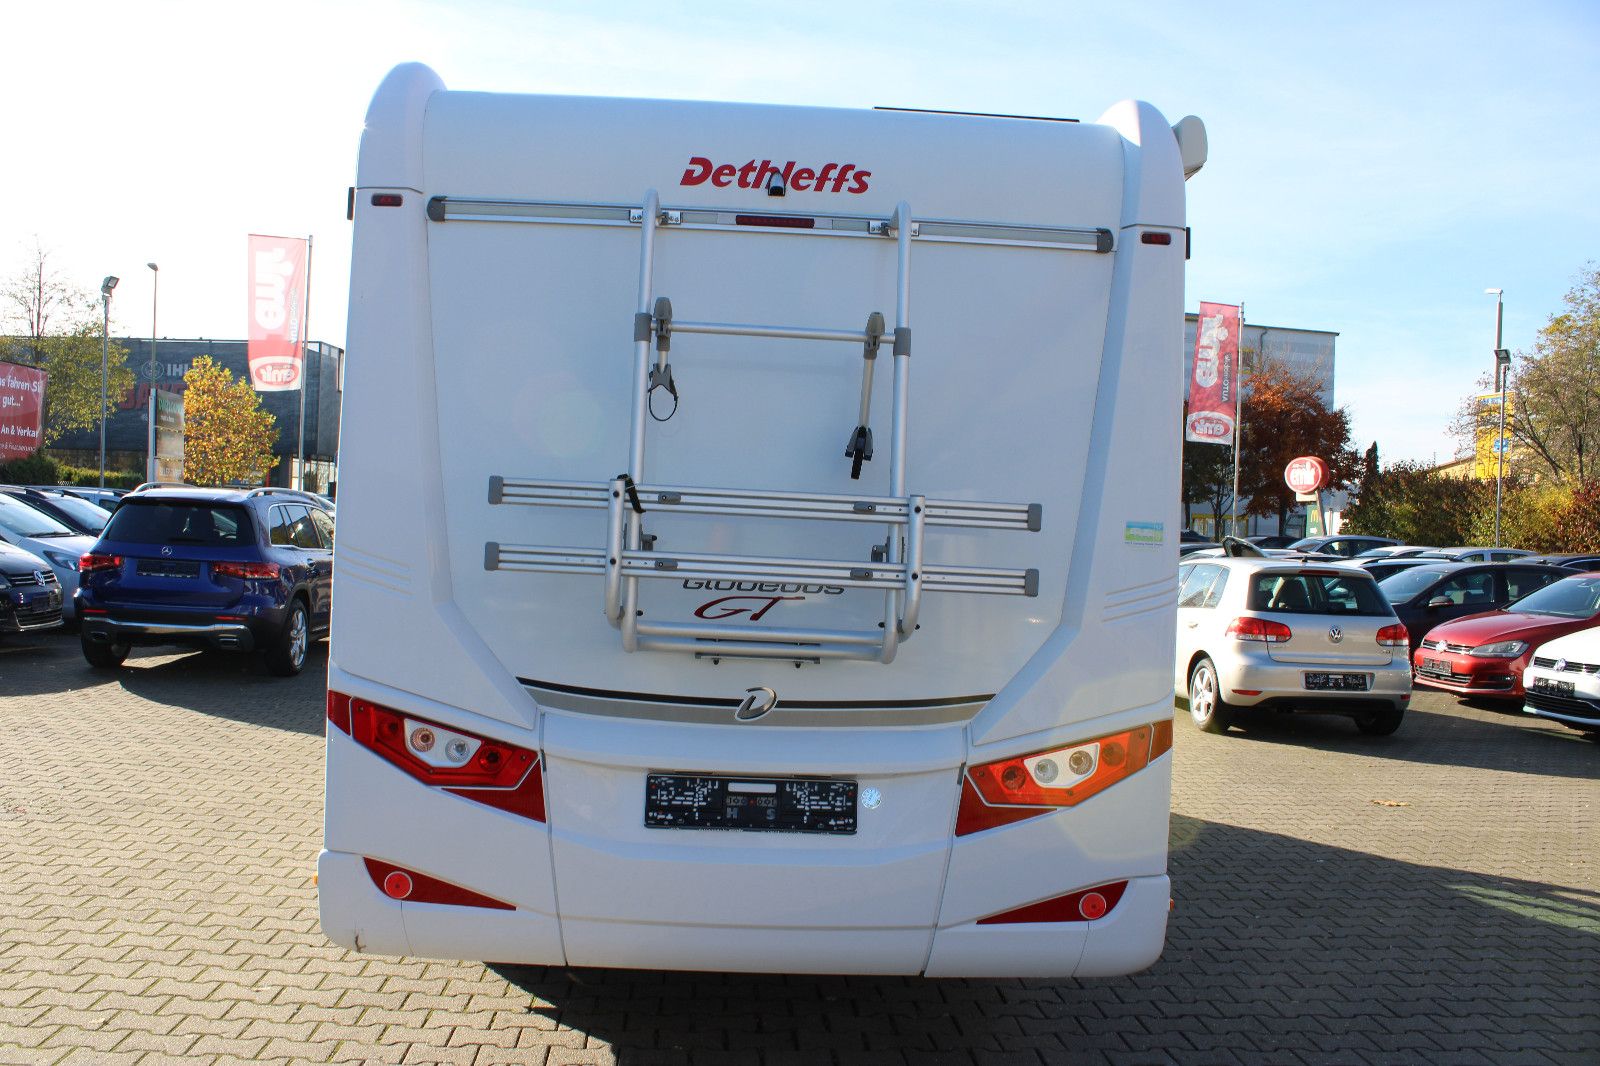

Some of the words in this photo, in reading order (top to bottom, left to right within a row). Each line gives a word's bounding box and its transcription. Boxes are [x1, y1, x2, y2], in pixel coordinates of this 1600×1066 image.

[680, 156, 872, 194] Dethleffs
[7, 375, 30, 391] fahren
[1, 424, 10, 435] An
[10, 424, 15, 435] &
[694, 596, 806, 622] GT
